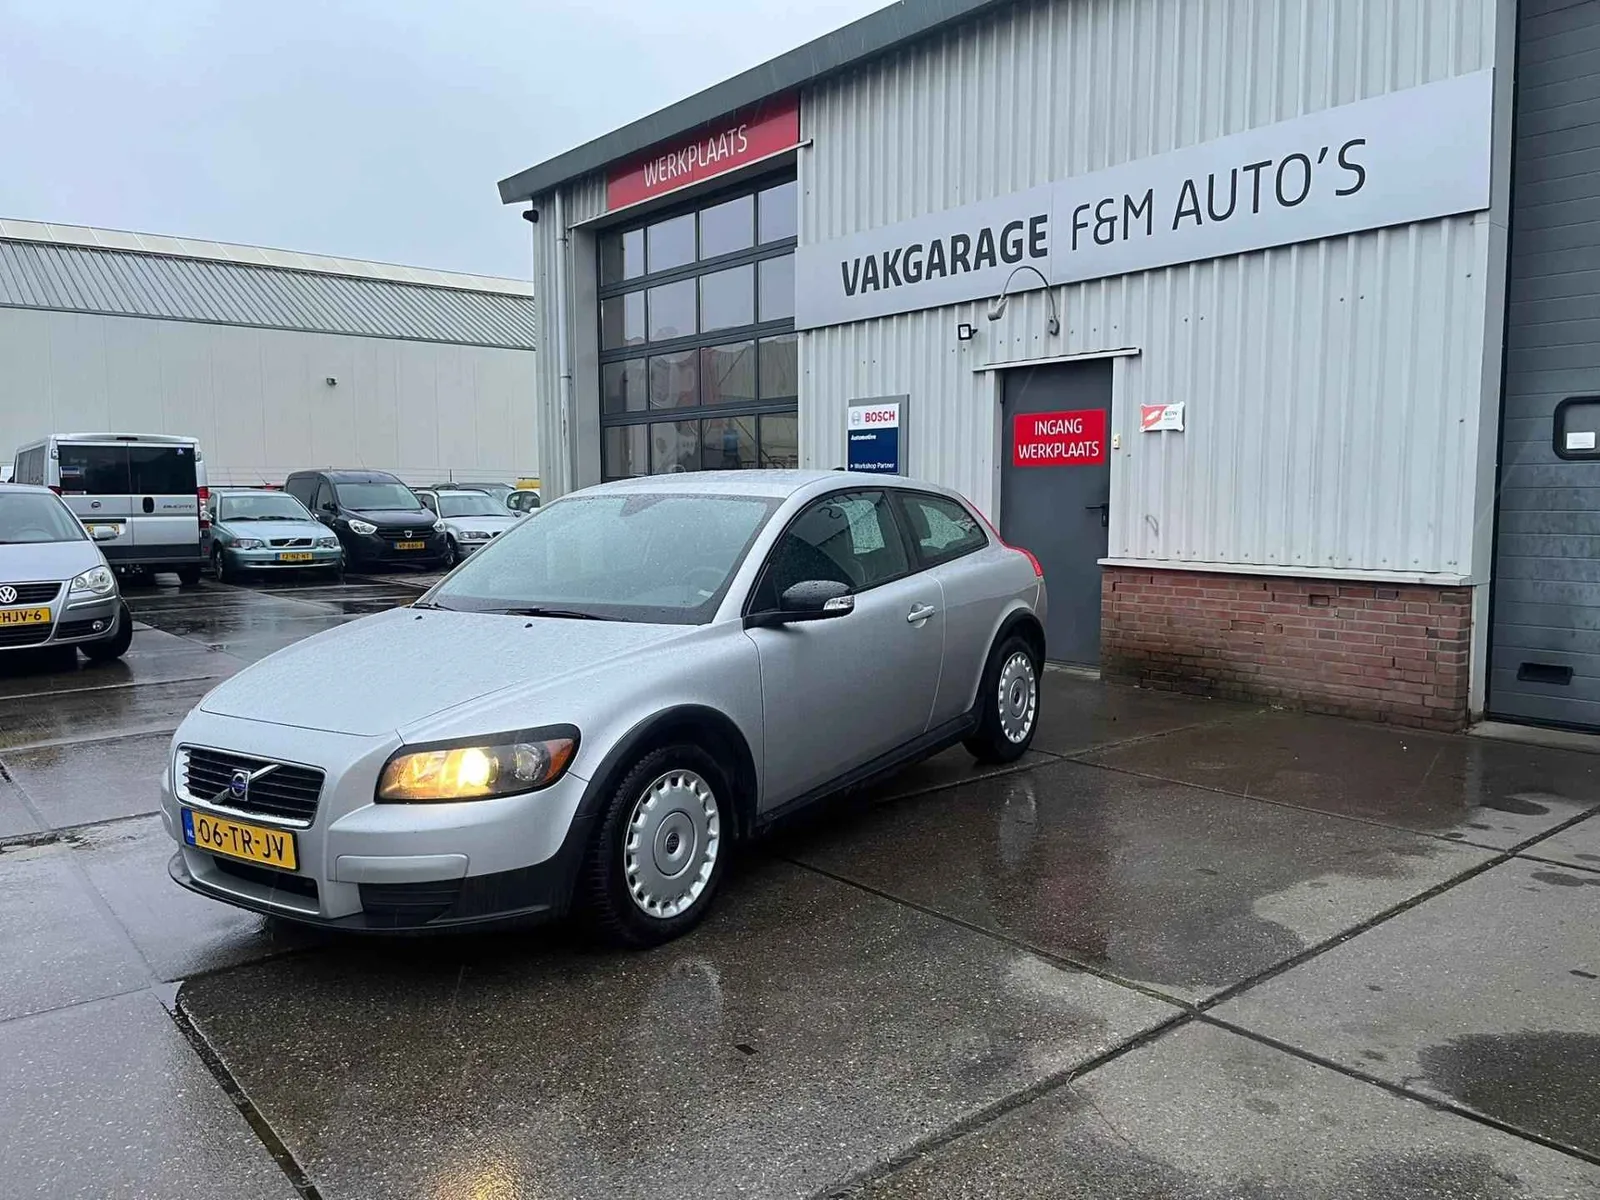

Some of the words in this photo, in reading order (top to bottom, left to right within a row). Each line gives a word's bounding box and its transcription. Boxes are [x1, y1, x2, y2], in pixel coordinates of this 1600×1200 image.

[643, 124, 748, 187] WERKPLAATS
[841, 214, 1048, 297] VAKGARAGE
[1071, 188, 1154, 251] F&M
[1171, 138, 1366, 231] AUTO'S
[864, 410, 896, 423] BOSCH
[1034, 418, 1083, 436] INGANG
[850, 433, 877, 441] Automotive
[1018, 440, 1100, 460] WERKPLAATS
[854, 462, 877, 470] Workshop
[199, 818, 284, 861] 06-TR-JV
